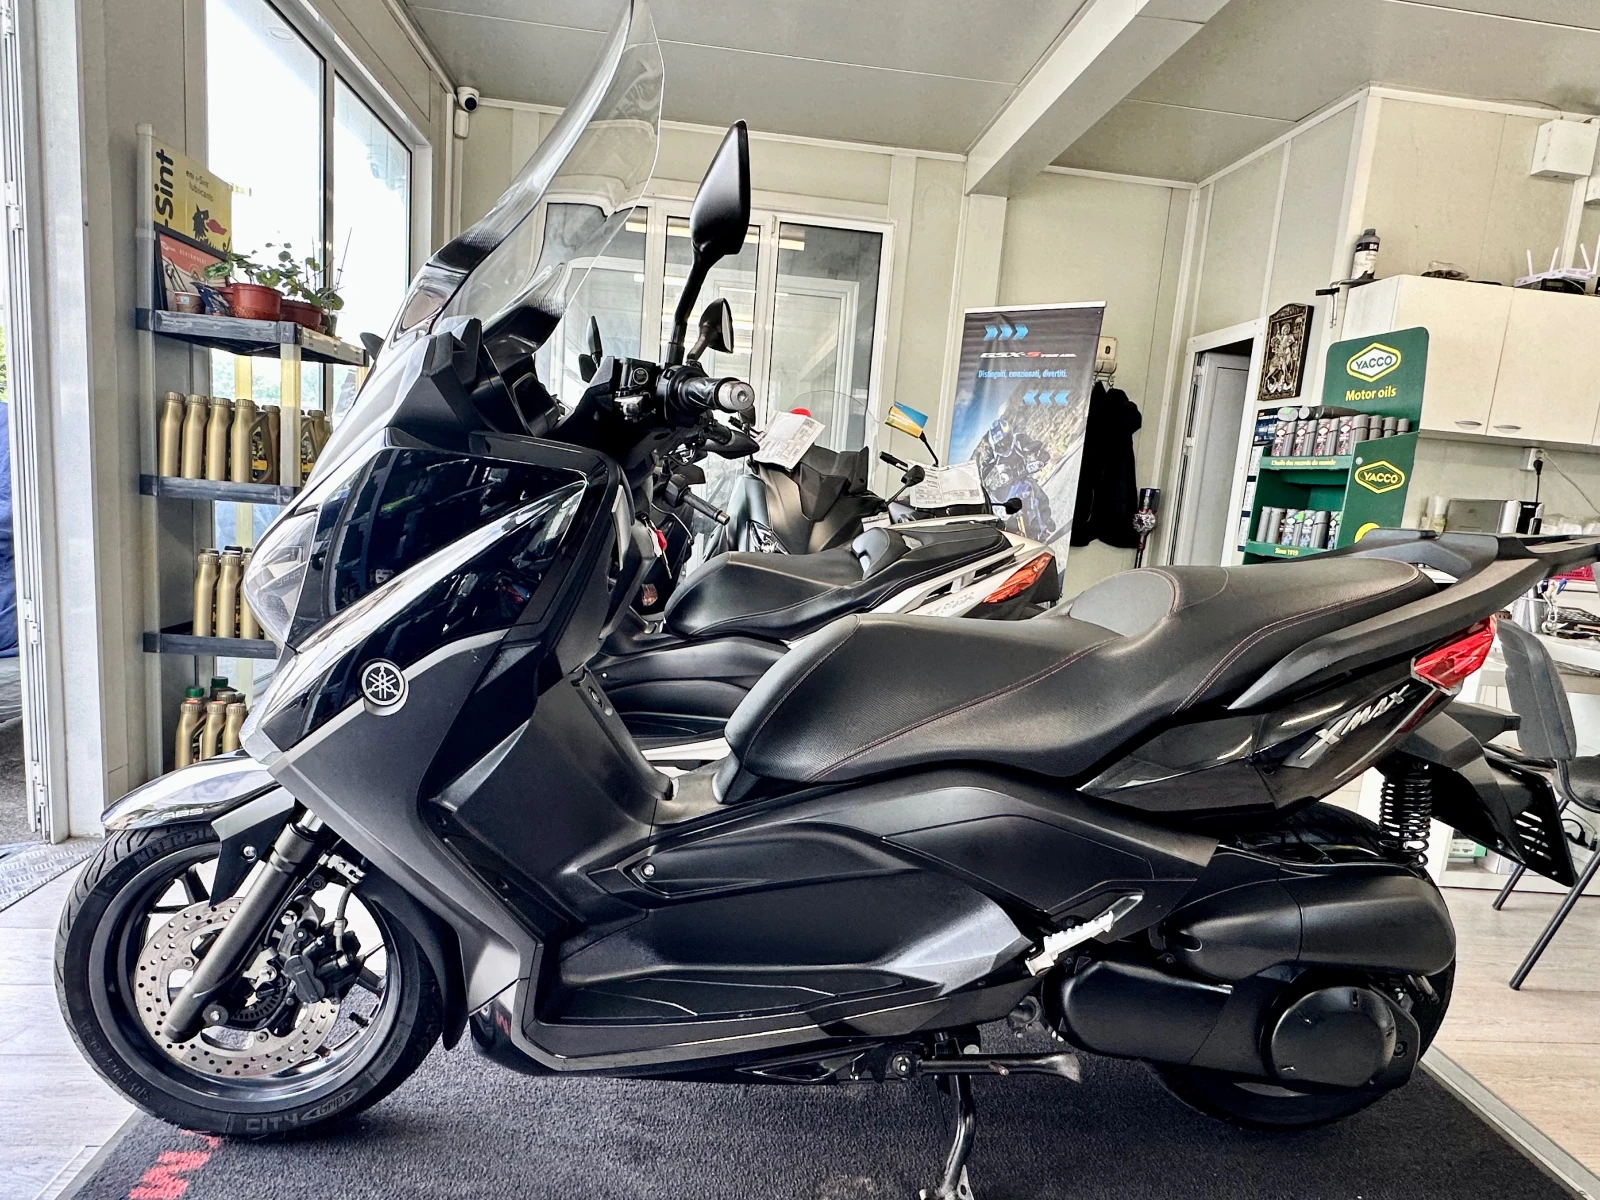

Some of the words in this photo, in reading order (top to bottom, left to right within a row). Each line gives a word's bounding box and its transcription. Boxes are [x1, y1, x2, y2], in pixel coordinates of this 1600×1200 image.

[1355, 355, 1393, 370] YACCO
[1345, 389, 1376, 402] Motor
[1377, 385, 1397, 398] oils
[1363, 471, 1399, 484] YACCO
[160, 807, 204, 821] ABS
[245, 1112, 300, 1132] CITY
